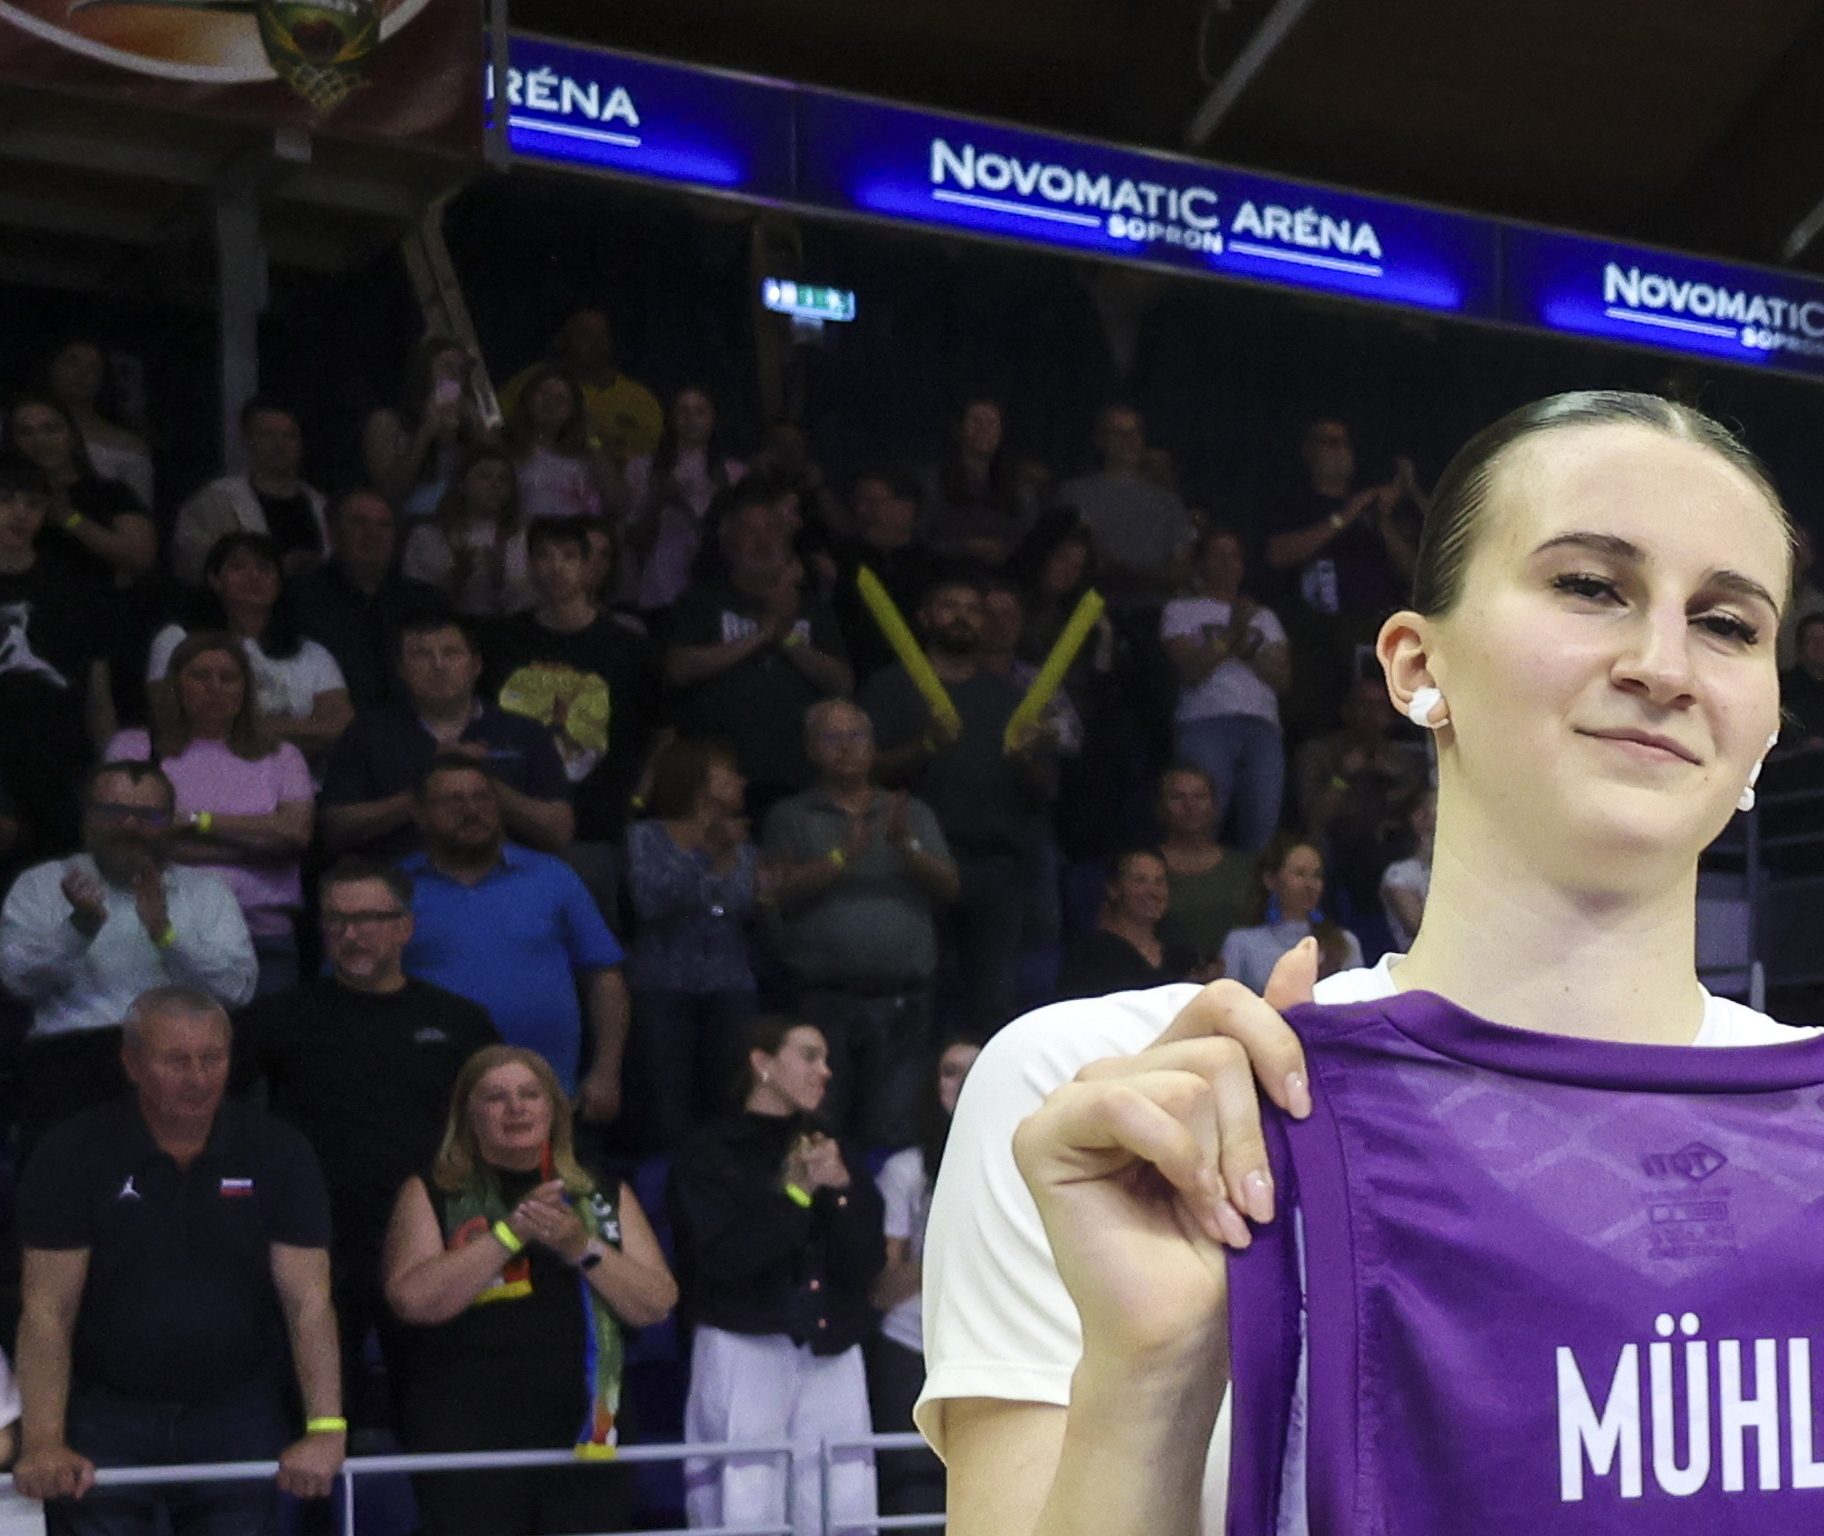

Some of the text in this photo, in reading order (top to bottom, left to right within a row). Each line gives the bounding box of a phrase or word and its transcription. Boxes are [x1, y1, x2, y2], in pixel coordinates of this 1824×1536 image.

[506, 66, 641, 127] RÉNA
[930, 138, 1382, 258] NOVOMATIC ARÉNA
[1107, 215, 1224, 255] SOPRON
